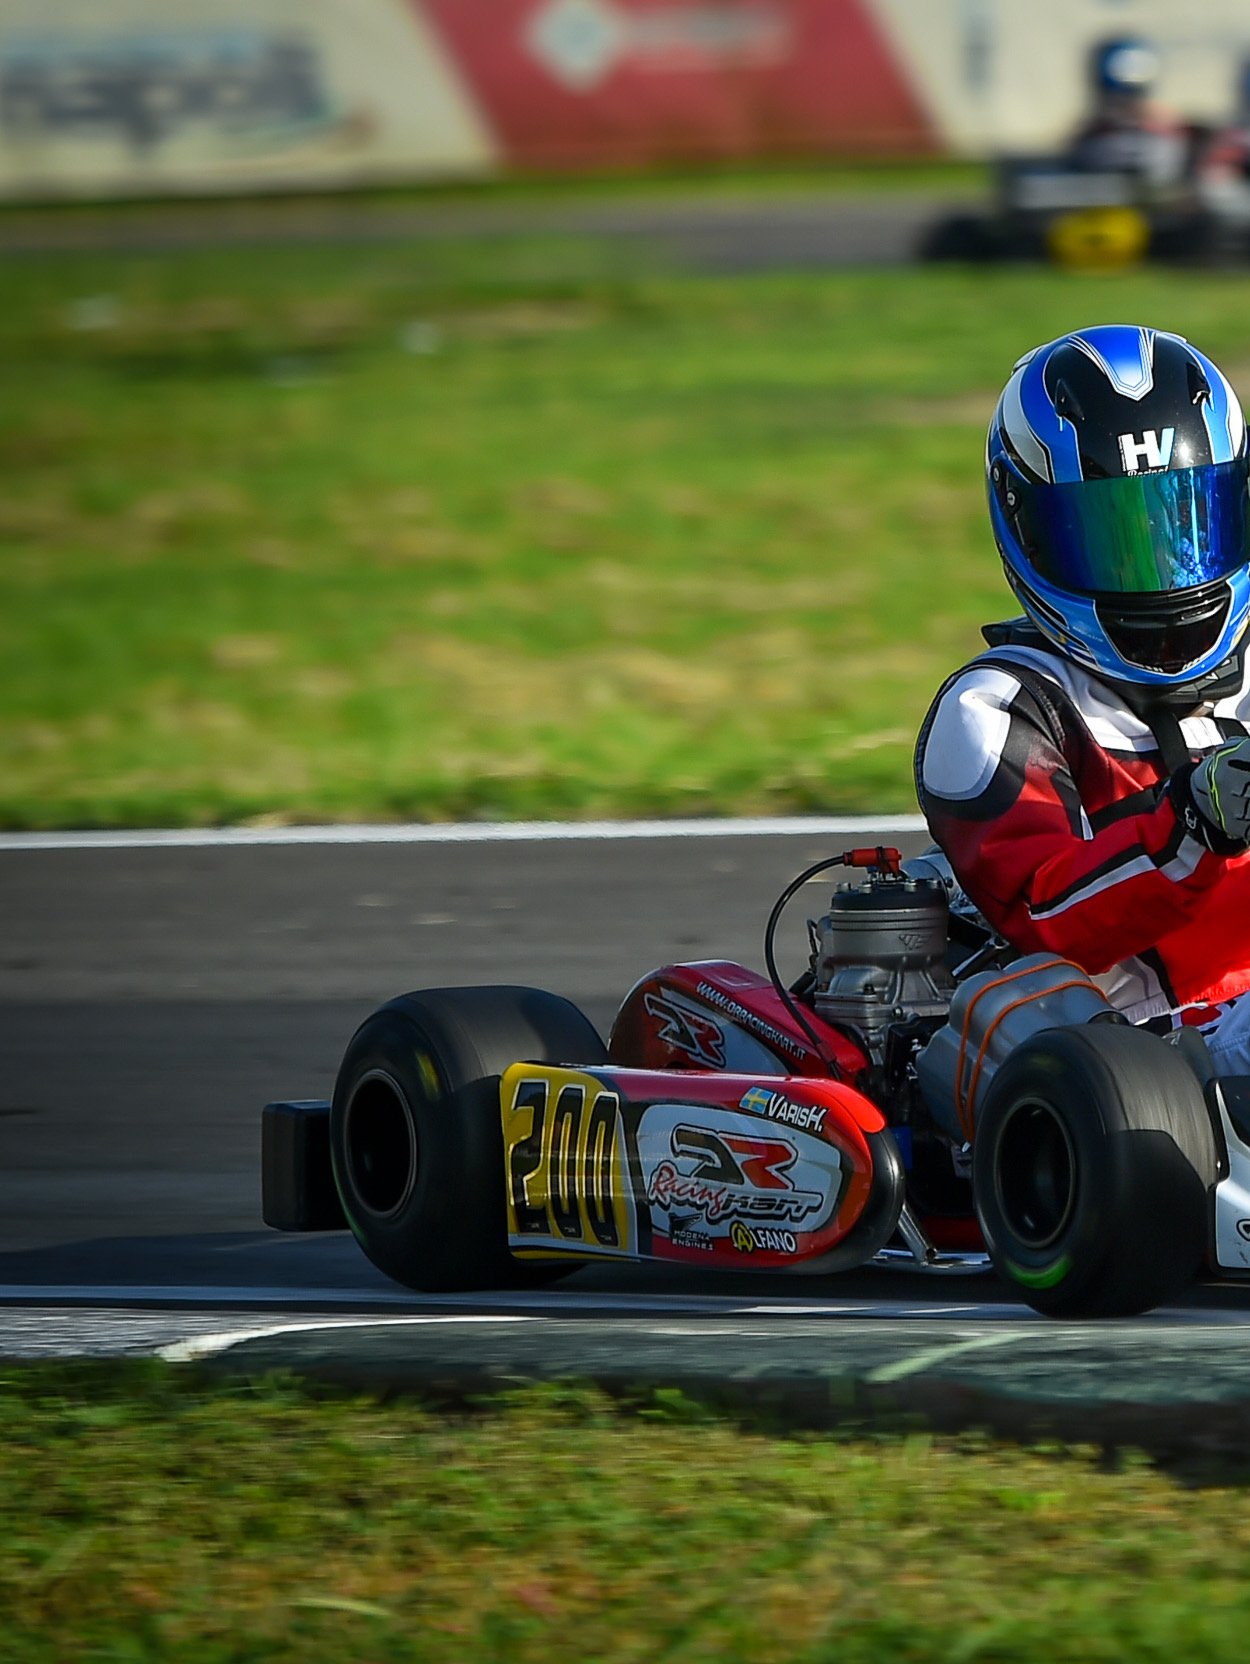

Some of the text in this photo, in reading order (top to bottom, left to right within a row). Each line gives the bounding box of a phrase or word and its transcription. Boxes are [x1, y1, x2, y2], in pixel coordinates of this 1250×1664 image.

[510, 1079, 620, 1247] 200
[672, 1238, 714, 1251] ENGINES
[673, 1230, 710, 1240] MODENA
[731, 1222, 797, 1253] ALFANO
